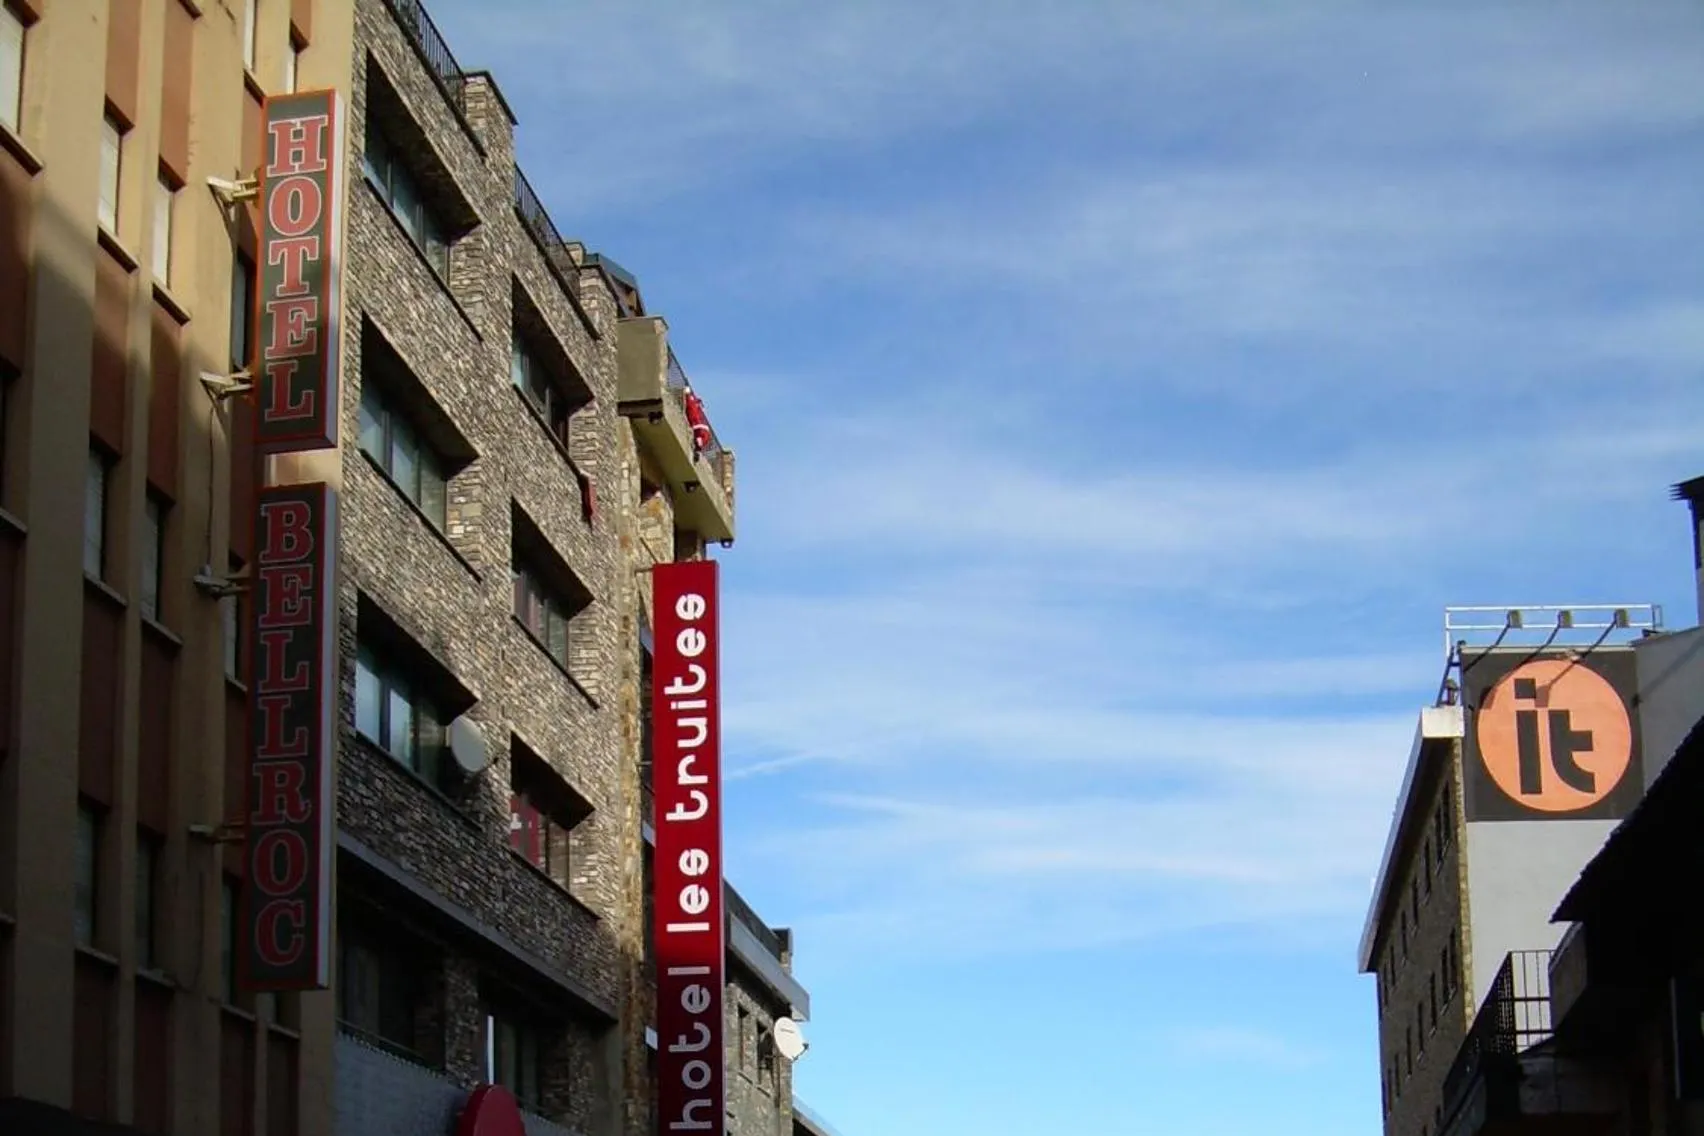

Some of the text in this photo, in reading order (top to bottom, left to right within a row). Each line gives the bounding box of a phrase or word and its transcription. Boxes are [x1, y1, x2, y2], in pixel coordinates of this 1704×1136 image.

[264, 114, 329, 423] HOTEL
[252, 500, 315, 967] BELLROC
[664, 592, 713, 1131] hotel les truites
[1513, 677, 1597, 795] it
